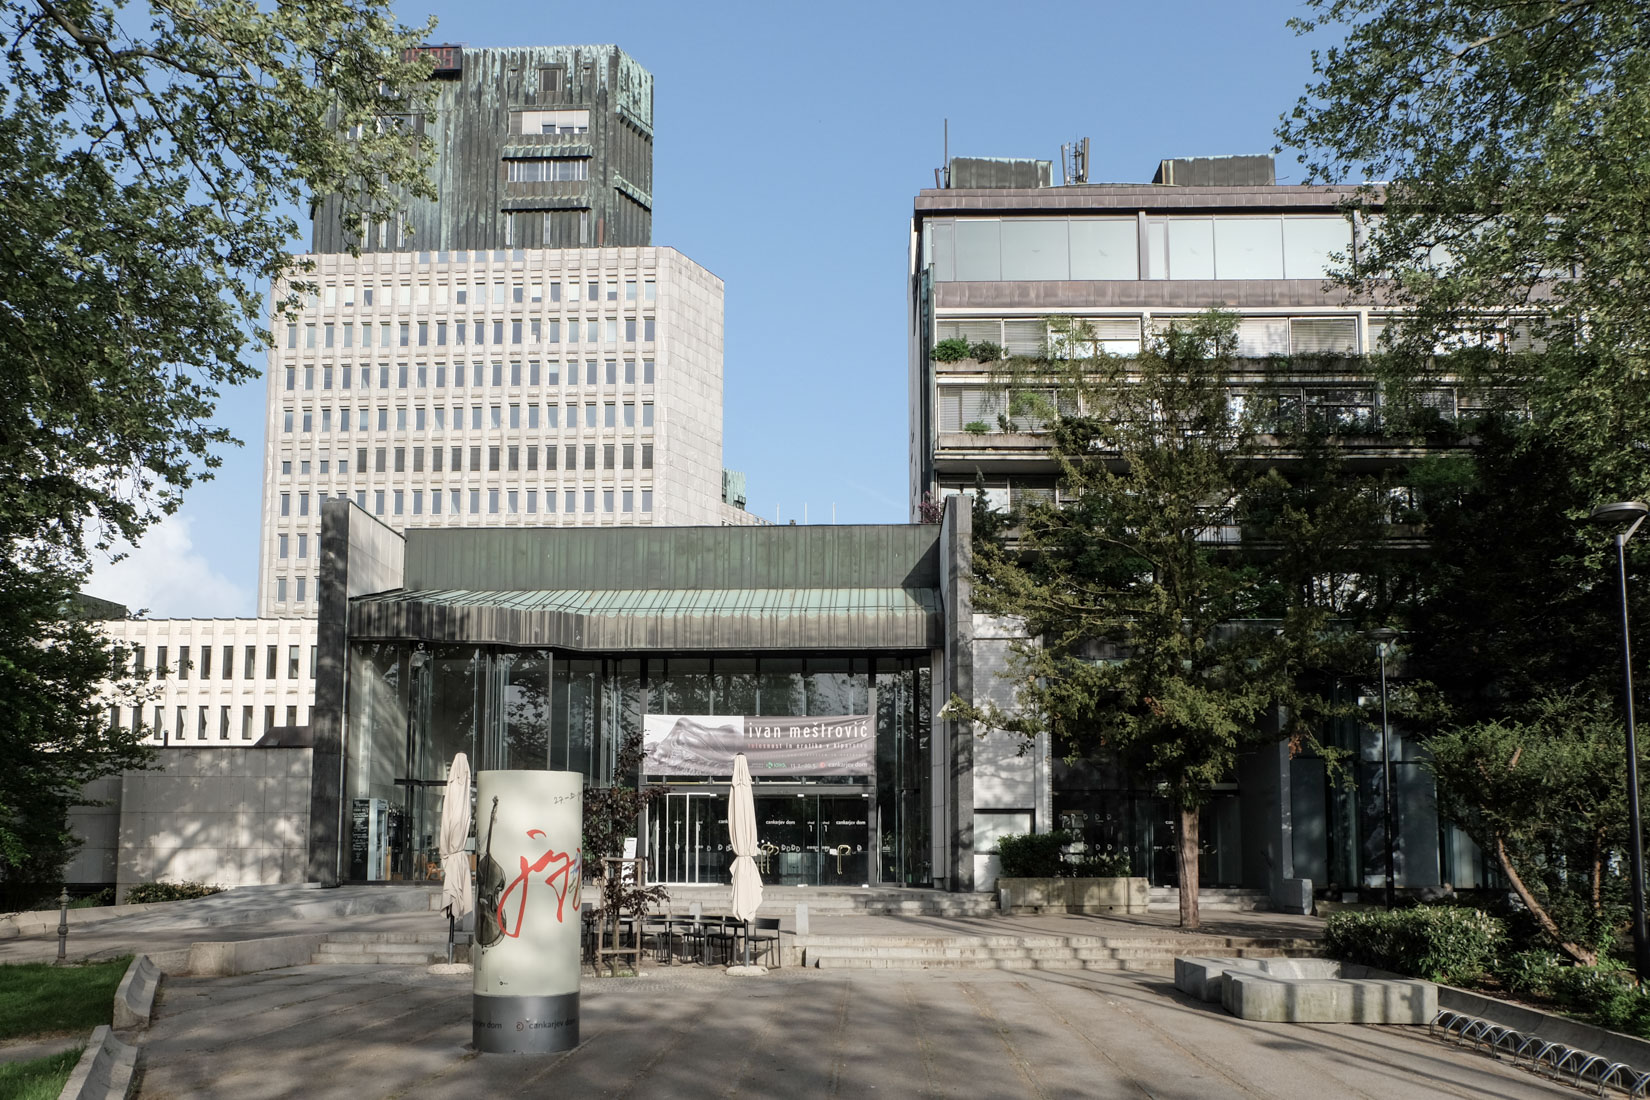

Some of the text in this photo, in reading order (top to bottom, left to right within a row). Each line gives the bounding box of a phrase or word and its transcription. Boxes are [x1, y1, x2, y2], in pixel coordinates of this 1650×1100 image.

[749, 721, 867, 738] ivan meštrović
[487, 1021, 502, 1029] dom
[529, 1021, 563, 1029] cankarjev
